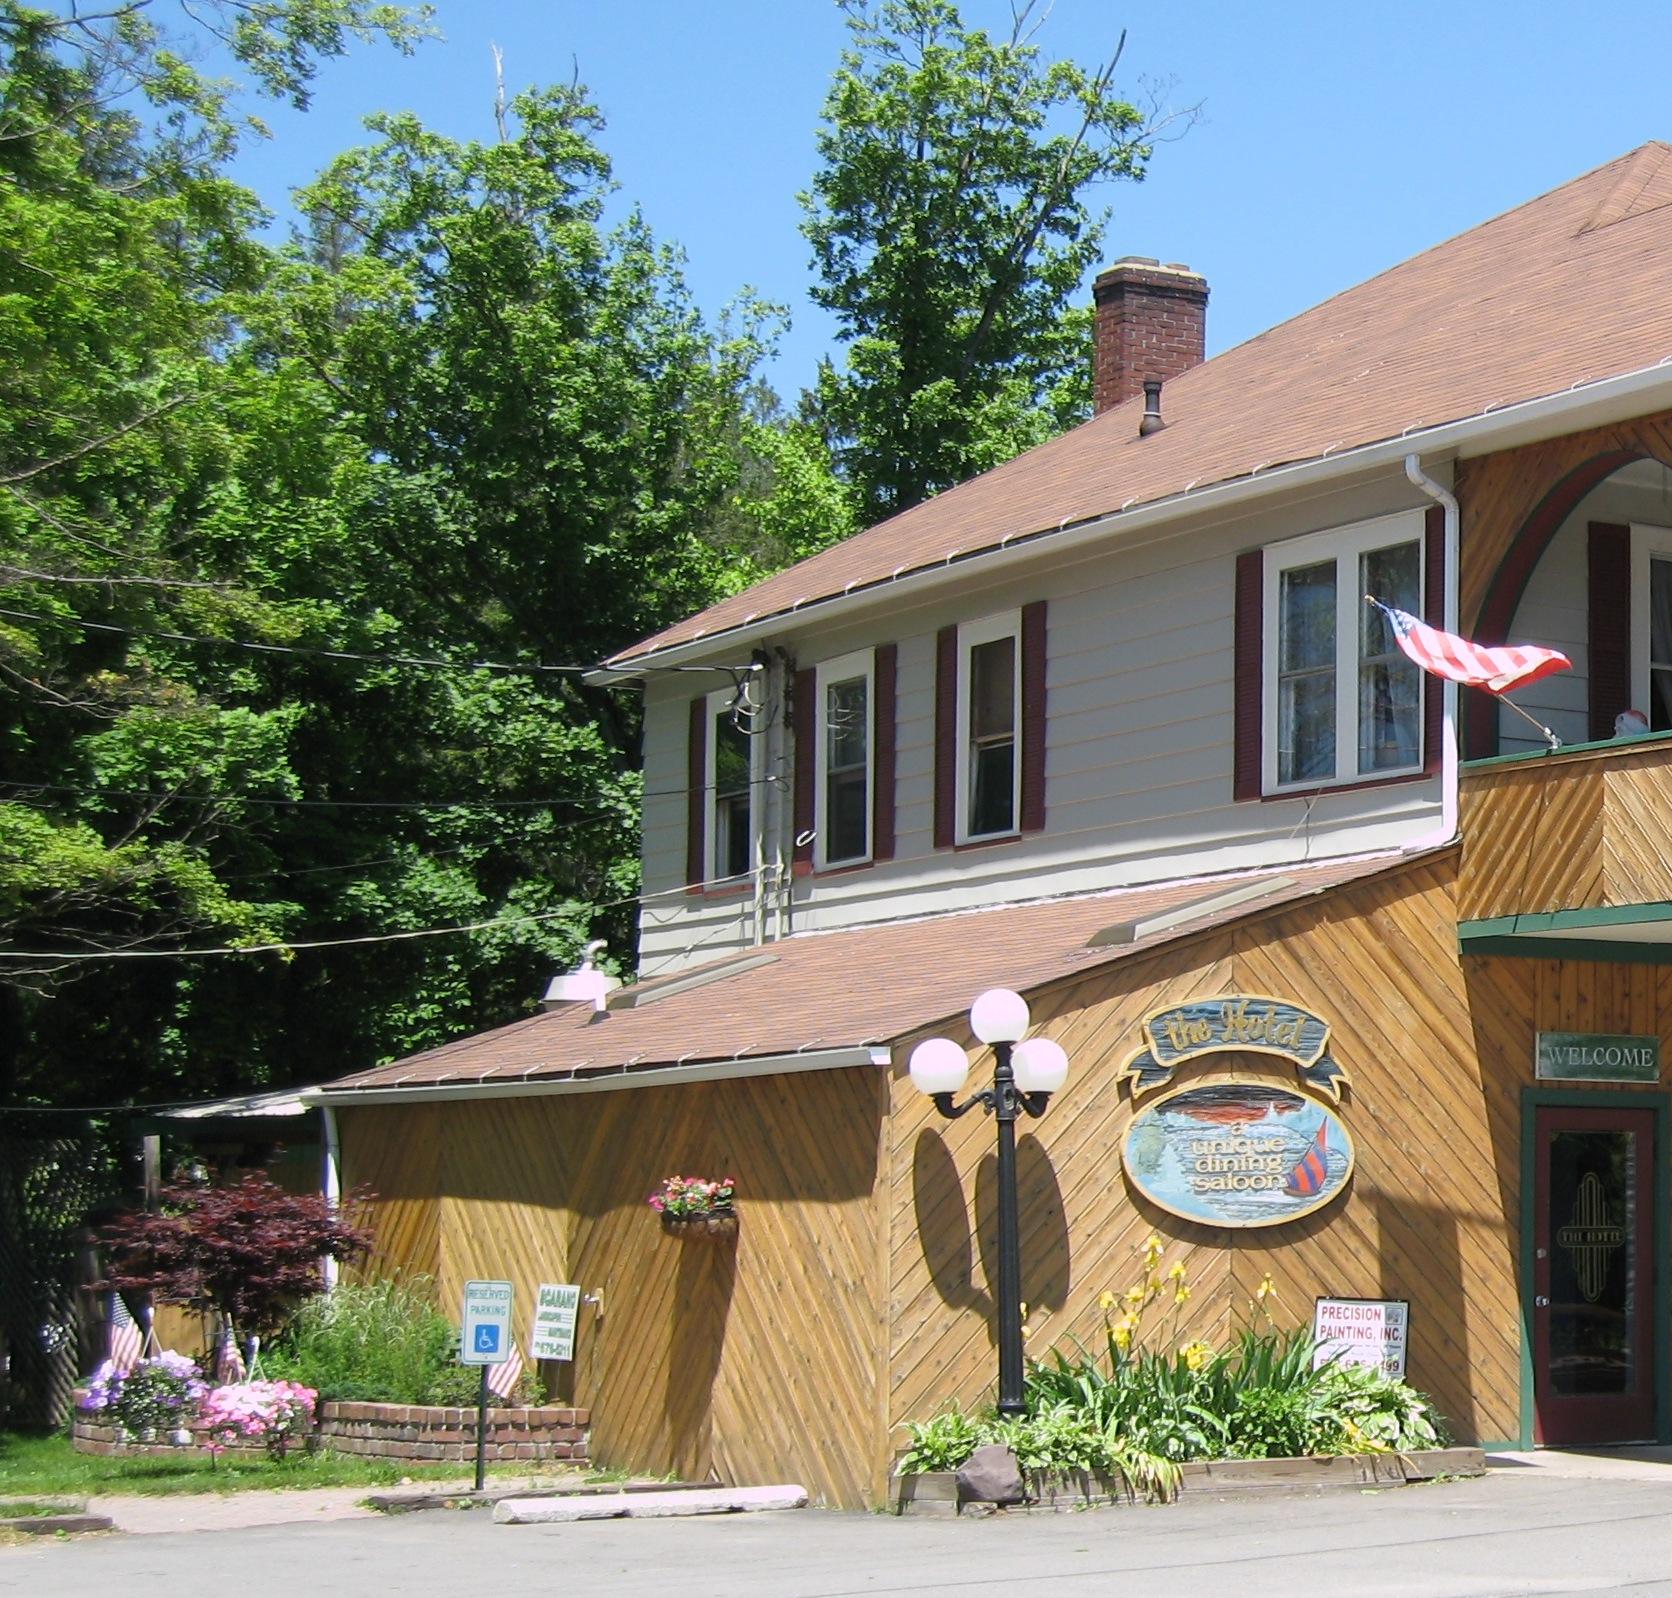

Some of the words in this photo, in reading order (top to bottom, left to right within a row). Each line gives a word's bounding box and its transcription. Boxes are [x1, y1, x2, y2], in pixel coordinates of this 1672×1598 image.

[1163, 1010, 1212, 1051] the
[1220, 1000, 1307, 1050] Hotel
[1549, 1046, 1654, 1067] WELCOME
[1231, 1120, 1244, 1136] a
[1191, 1135, 1286, 1157] unique
[1195, 1153, 1283, 1174] dining
[1192, 1172, 1287, 1191] saloon
[467, 1289, 510, 1300] RESERVED
[470, 1305, 507, 1316] PARKING
[1321, 1306, 1382, 1321] PRECISION
[1320, 1325, 1376, 1342] PAINTING,
[1380, 1327, 1403, 1341] INC.
